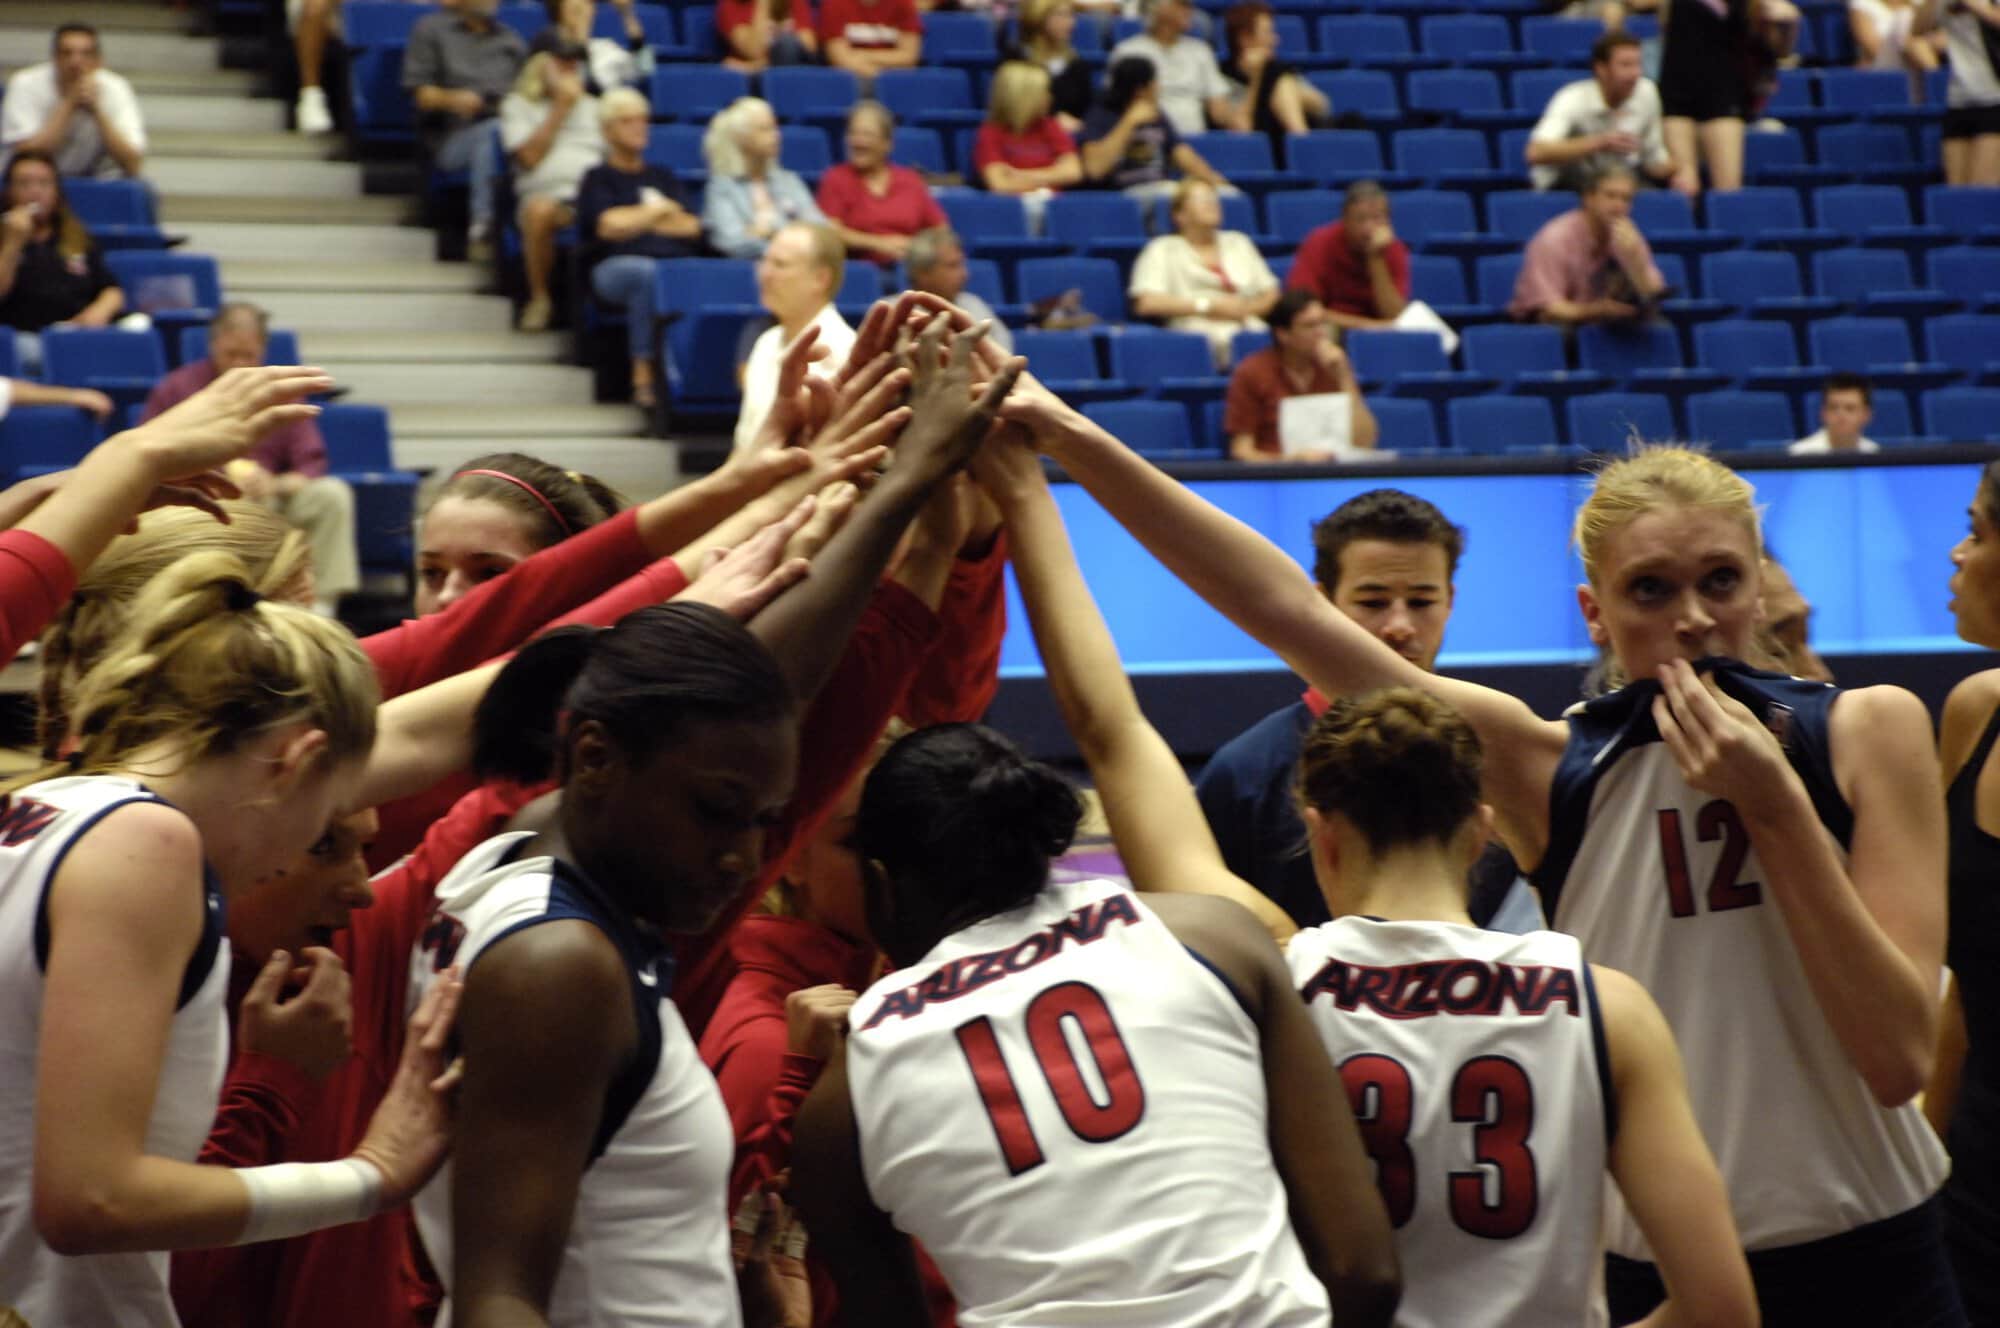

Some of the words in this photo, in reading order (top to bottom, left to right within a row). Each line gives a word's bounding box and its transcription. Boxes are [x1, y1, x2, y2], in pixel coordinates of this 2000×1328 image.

[1656, 797, 1763, 918] 12
[859, 893, 1141, 1031] ARIZONA
[1301, 956, 1580, 1020] ARIZONA
[954, 979, 1145, 1177] 10
